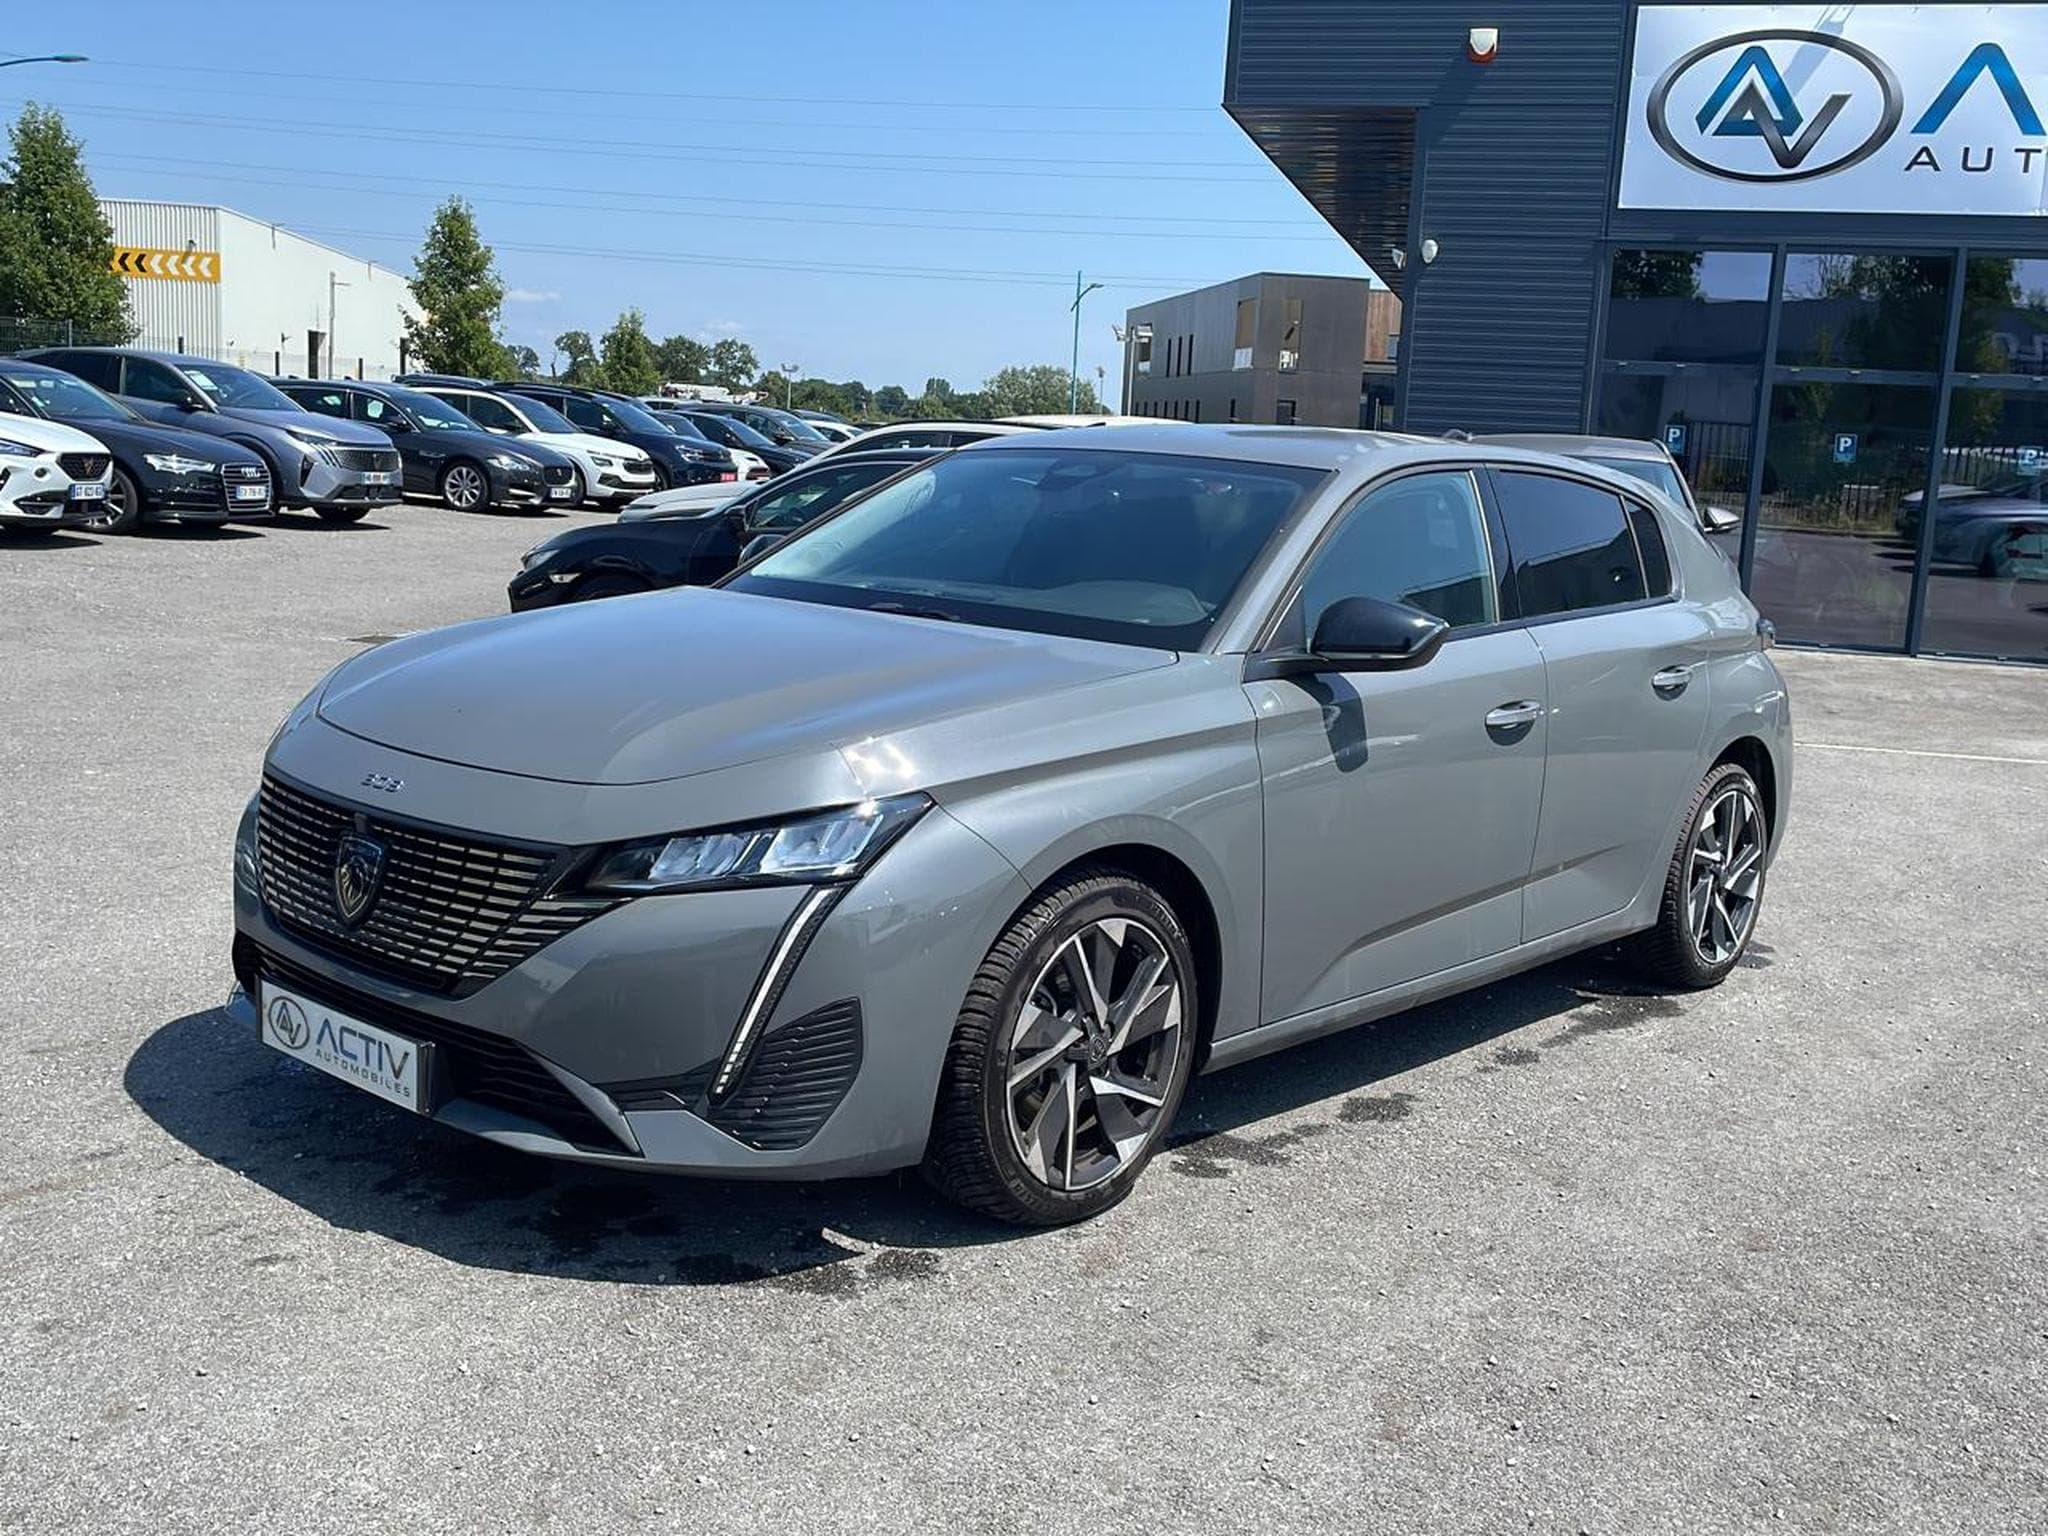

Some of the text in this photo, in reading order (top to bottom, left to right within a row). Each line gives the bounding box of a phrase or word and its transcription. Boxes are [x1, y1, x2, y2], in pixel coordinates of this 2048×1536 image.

[1904, 146, 2043, 174] AUT
[1667, 428, 1681, 443] P
[1839, 437, 1852, 452] P
[316, 1017, 410, 1080] ACTIV
[315, 1049, 411, 1098] AUTOMOBILES
